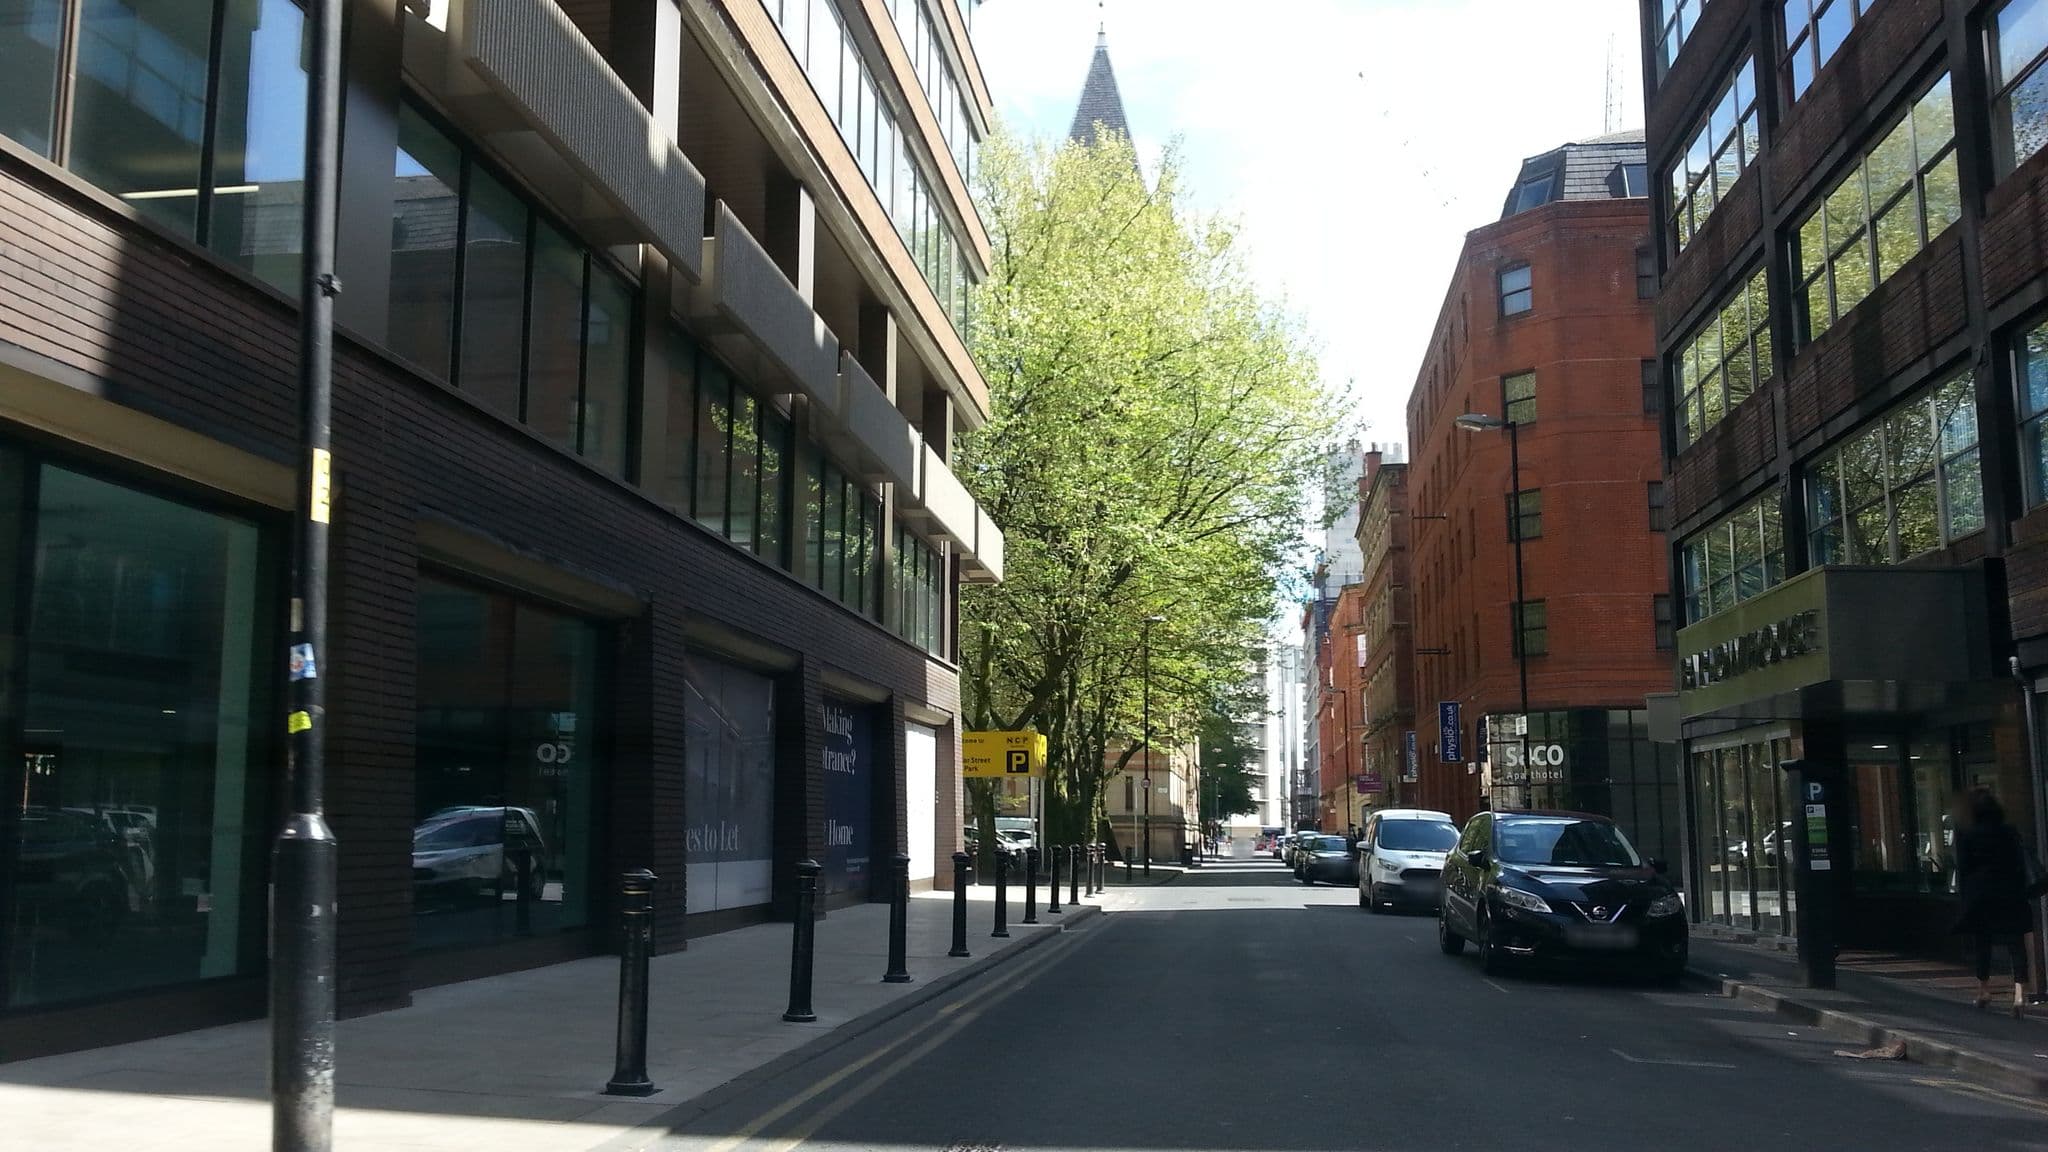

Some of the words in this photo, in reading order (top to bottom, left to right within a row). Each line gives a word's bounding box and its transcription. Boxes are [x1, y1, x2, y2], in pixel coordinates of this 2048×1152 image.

[823, 746, 857, 776] trance?
[1506, 769, 1563, 781] Apathotel
[828, 819, 854, 846] Home
